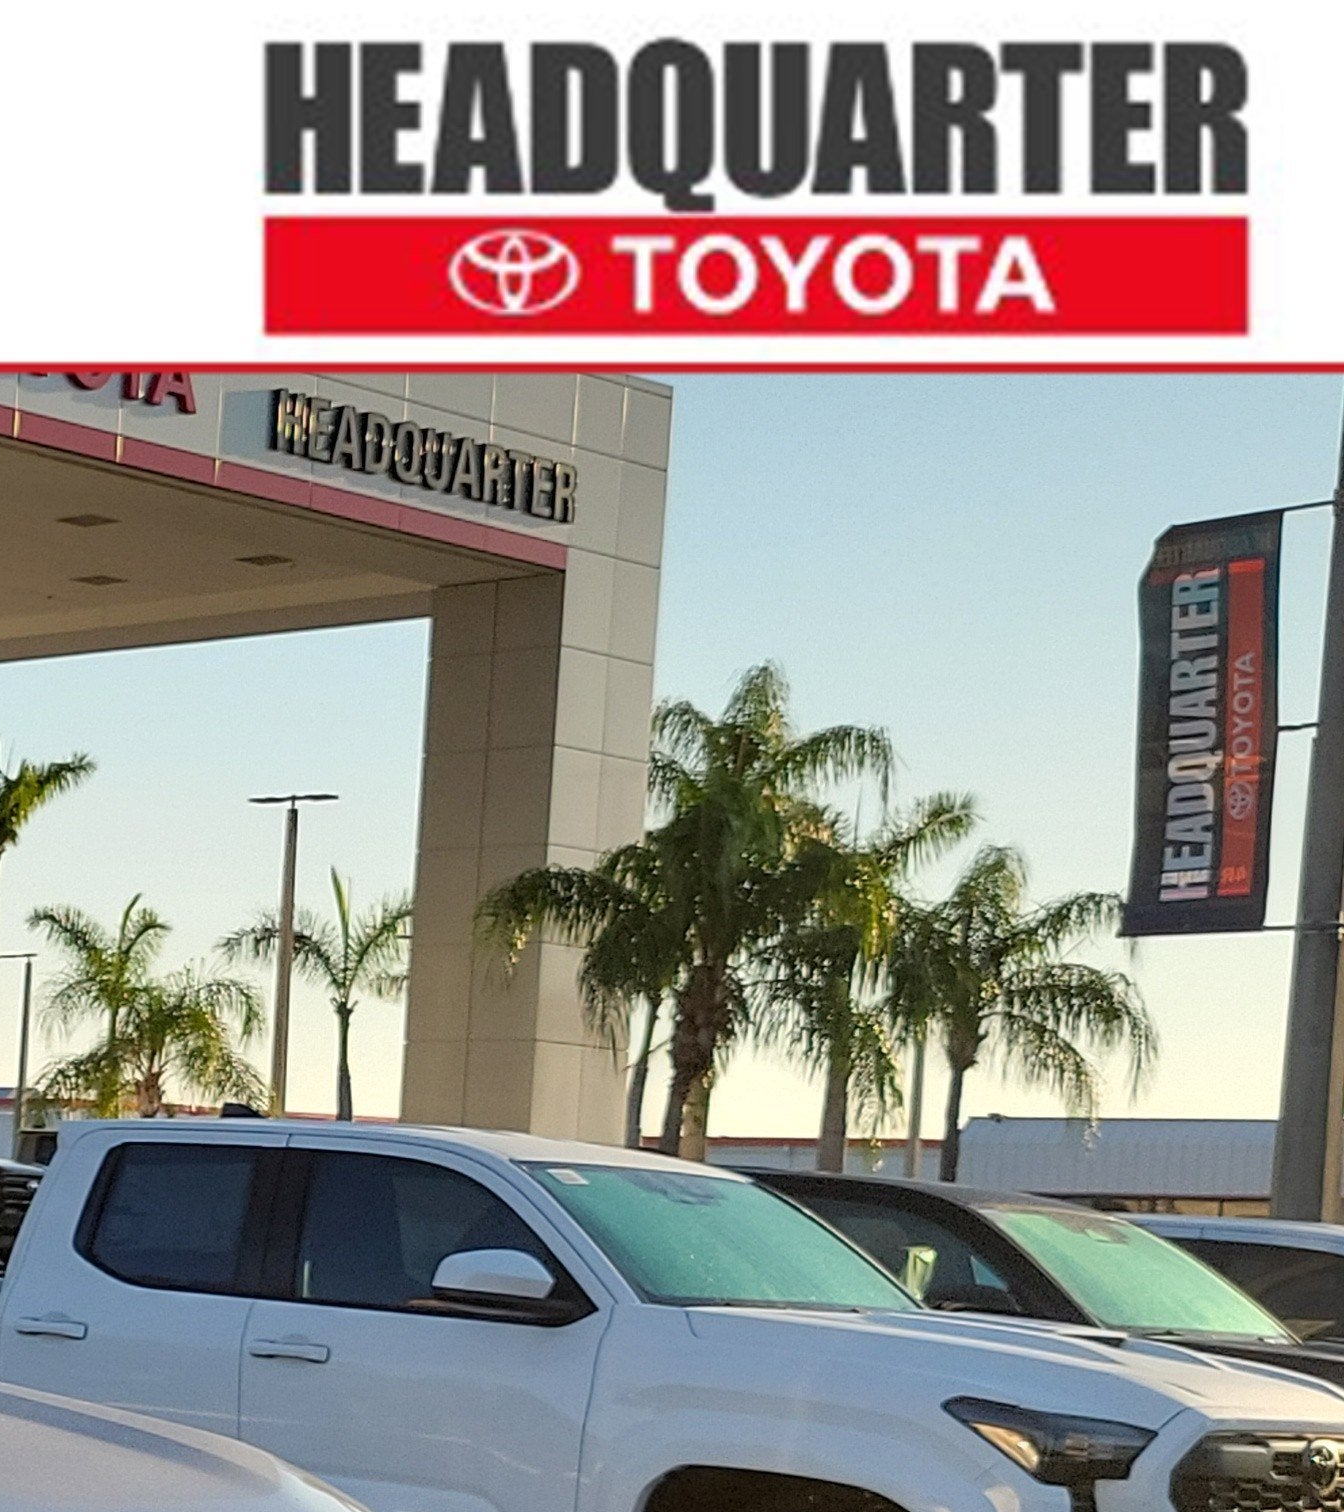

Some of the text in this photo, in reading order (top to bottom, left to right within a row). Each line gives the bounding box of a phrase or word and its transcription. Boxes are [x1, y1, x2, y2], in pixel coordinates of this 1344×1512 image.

[267, 388, 578, 524] HEADQUARTER
[1159, 567, 1223, 902] HEADQUARTER
[1229, 650, 1257, 780] TOYOTA
